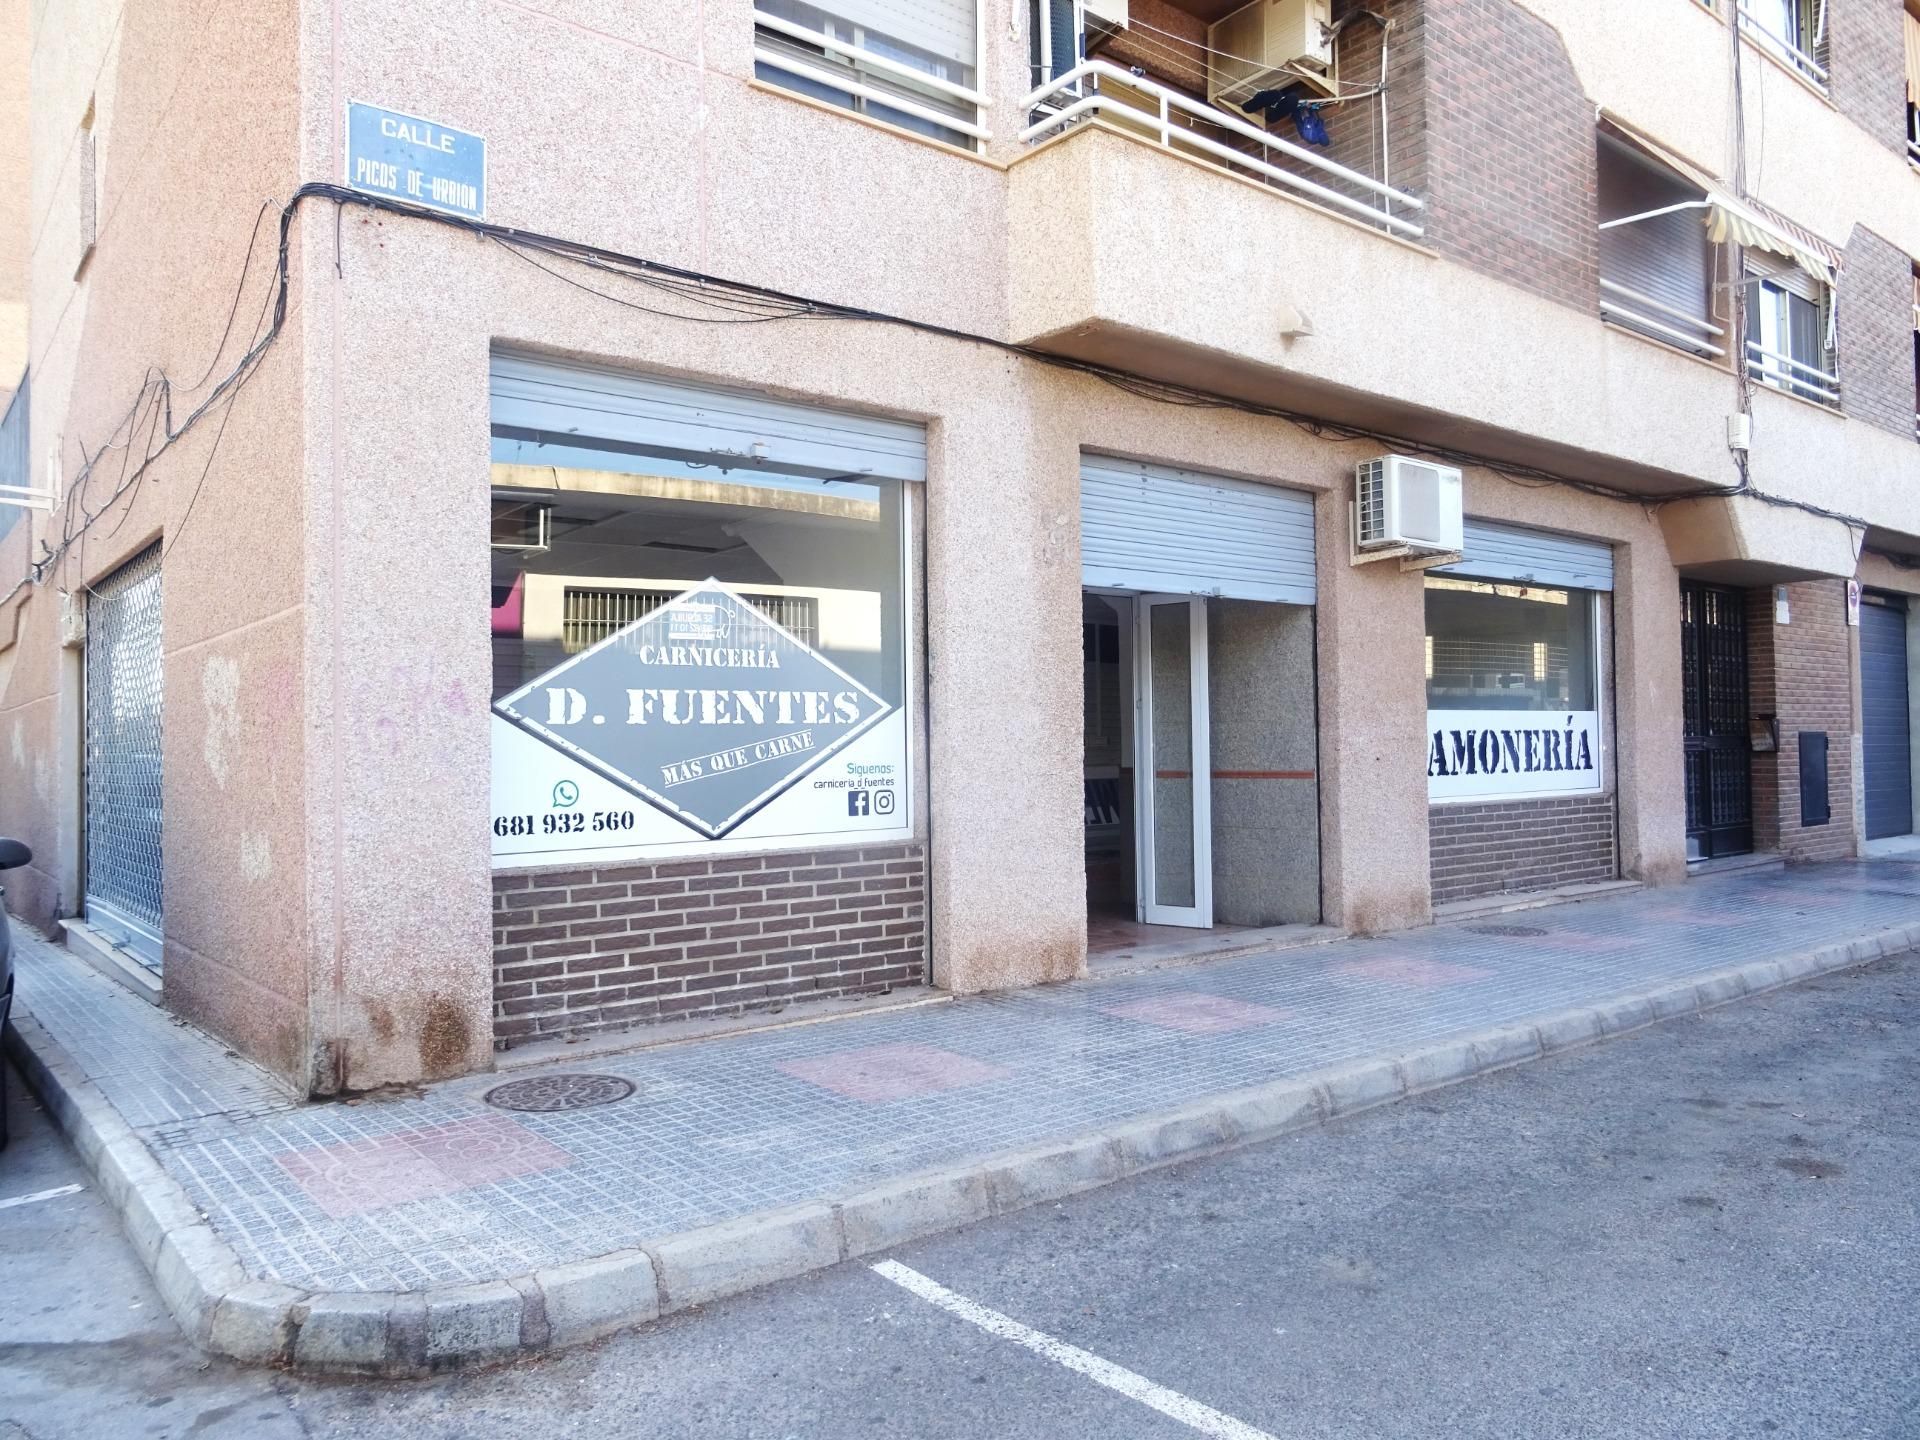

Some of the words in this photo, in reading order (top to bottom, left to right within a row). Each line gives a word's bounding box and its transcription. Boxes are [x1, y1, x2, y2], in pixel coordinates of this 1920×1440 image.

[381, 118, 455, 154] CALLE
[356, 157, 397, 190] PICOS
[407, 169, 424, 197] DE
[639, 644, 780, 668] CARNICERÍA
[546, 687, 606, 725] D.
[626, 688, 860, 725] FUENTES
[661, 759, 702, 785] MÁS
[710, 749, 748, 772] QUE
[755, 732, 814, 760] CARNE
[1428, 714, 1593, 776] AMONERÍA
[493, 816, 535, 836] 681
[543, 812, 585, 834] 932
[592, 810, 634, 831] 560
